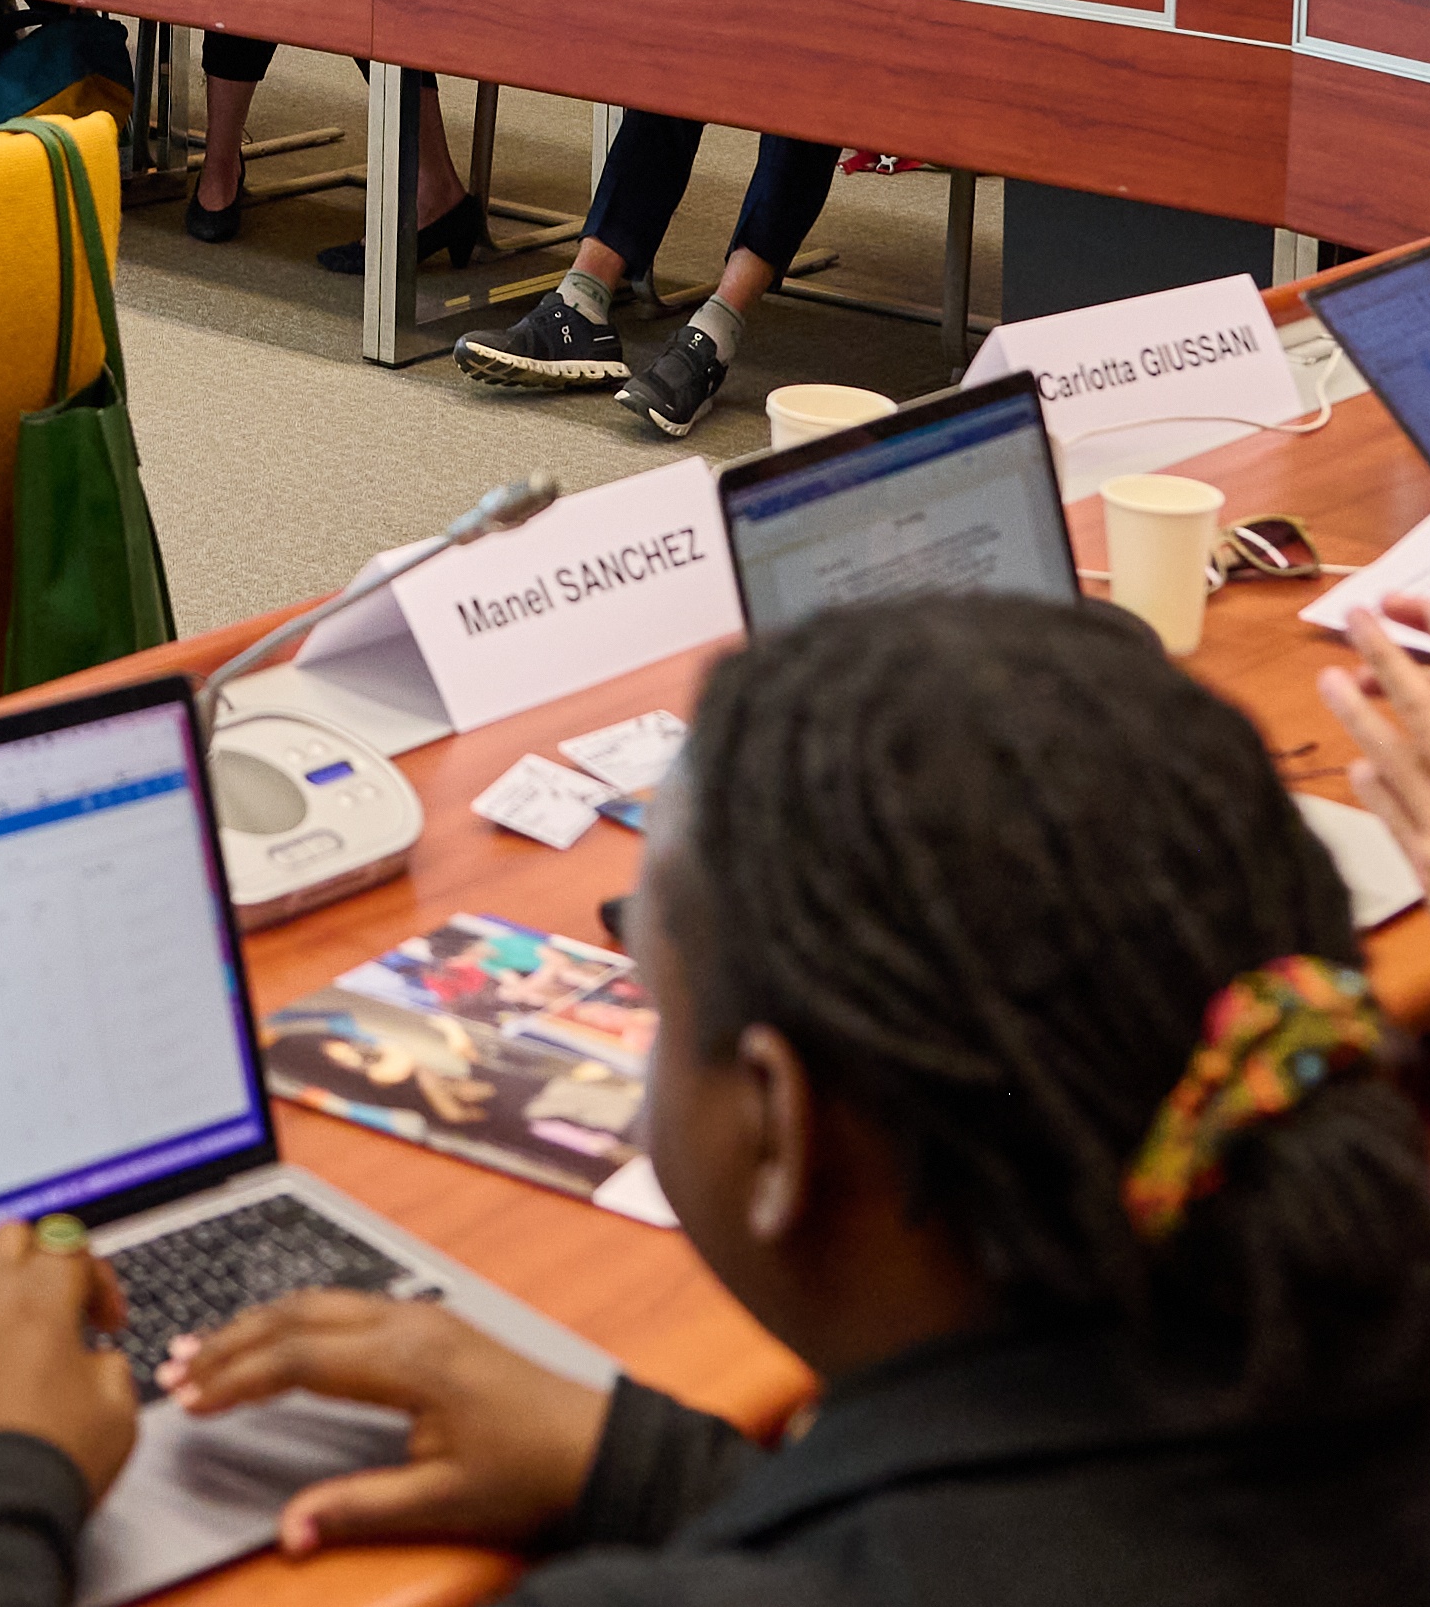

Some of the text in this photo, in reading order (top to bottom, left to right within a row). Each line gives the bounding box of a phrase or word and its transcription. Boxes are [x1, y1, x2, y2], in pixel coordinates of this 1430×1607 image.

[1037, 323, 1261, 401] Carlotta GIUSSANI
[455, 526, 707, 638] Manel SANCHEZ
